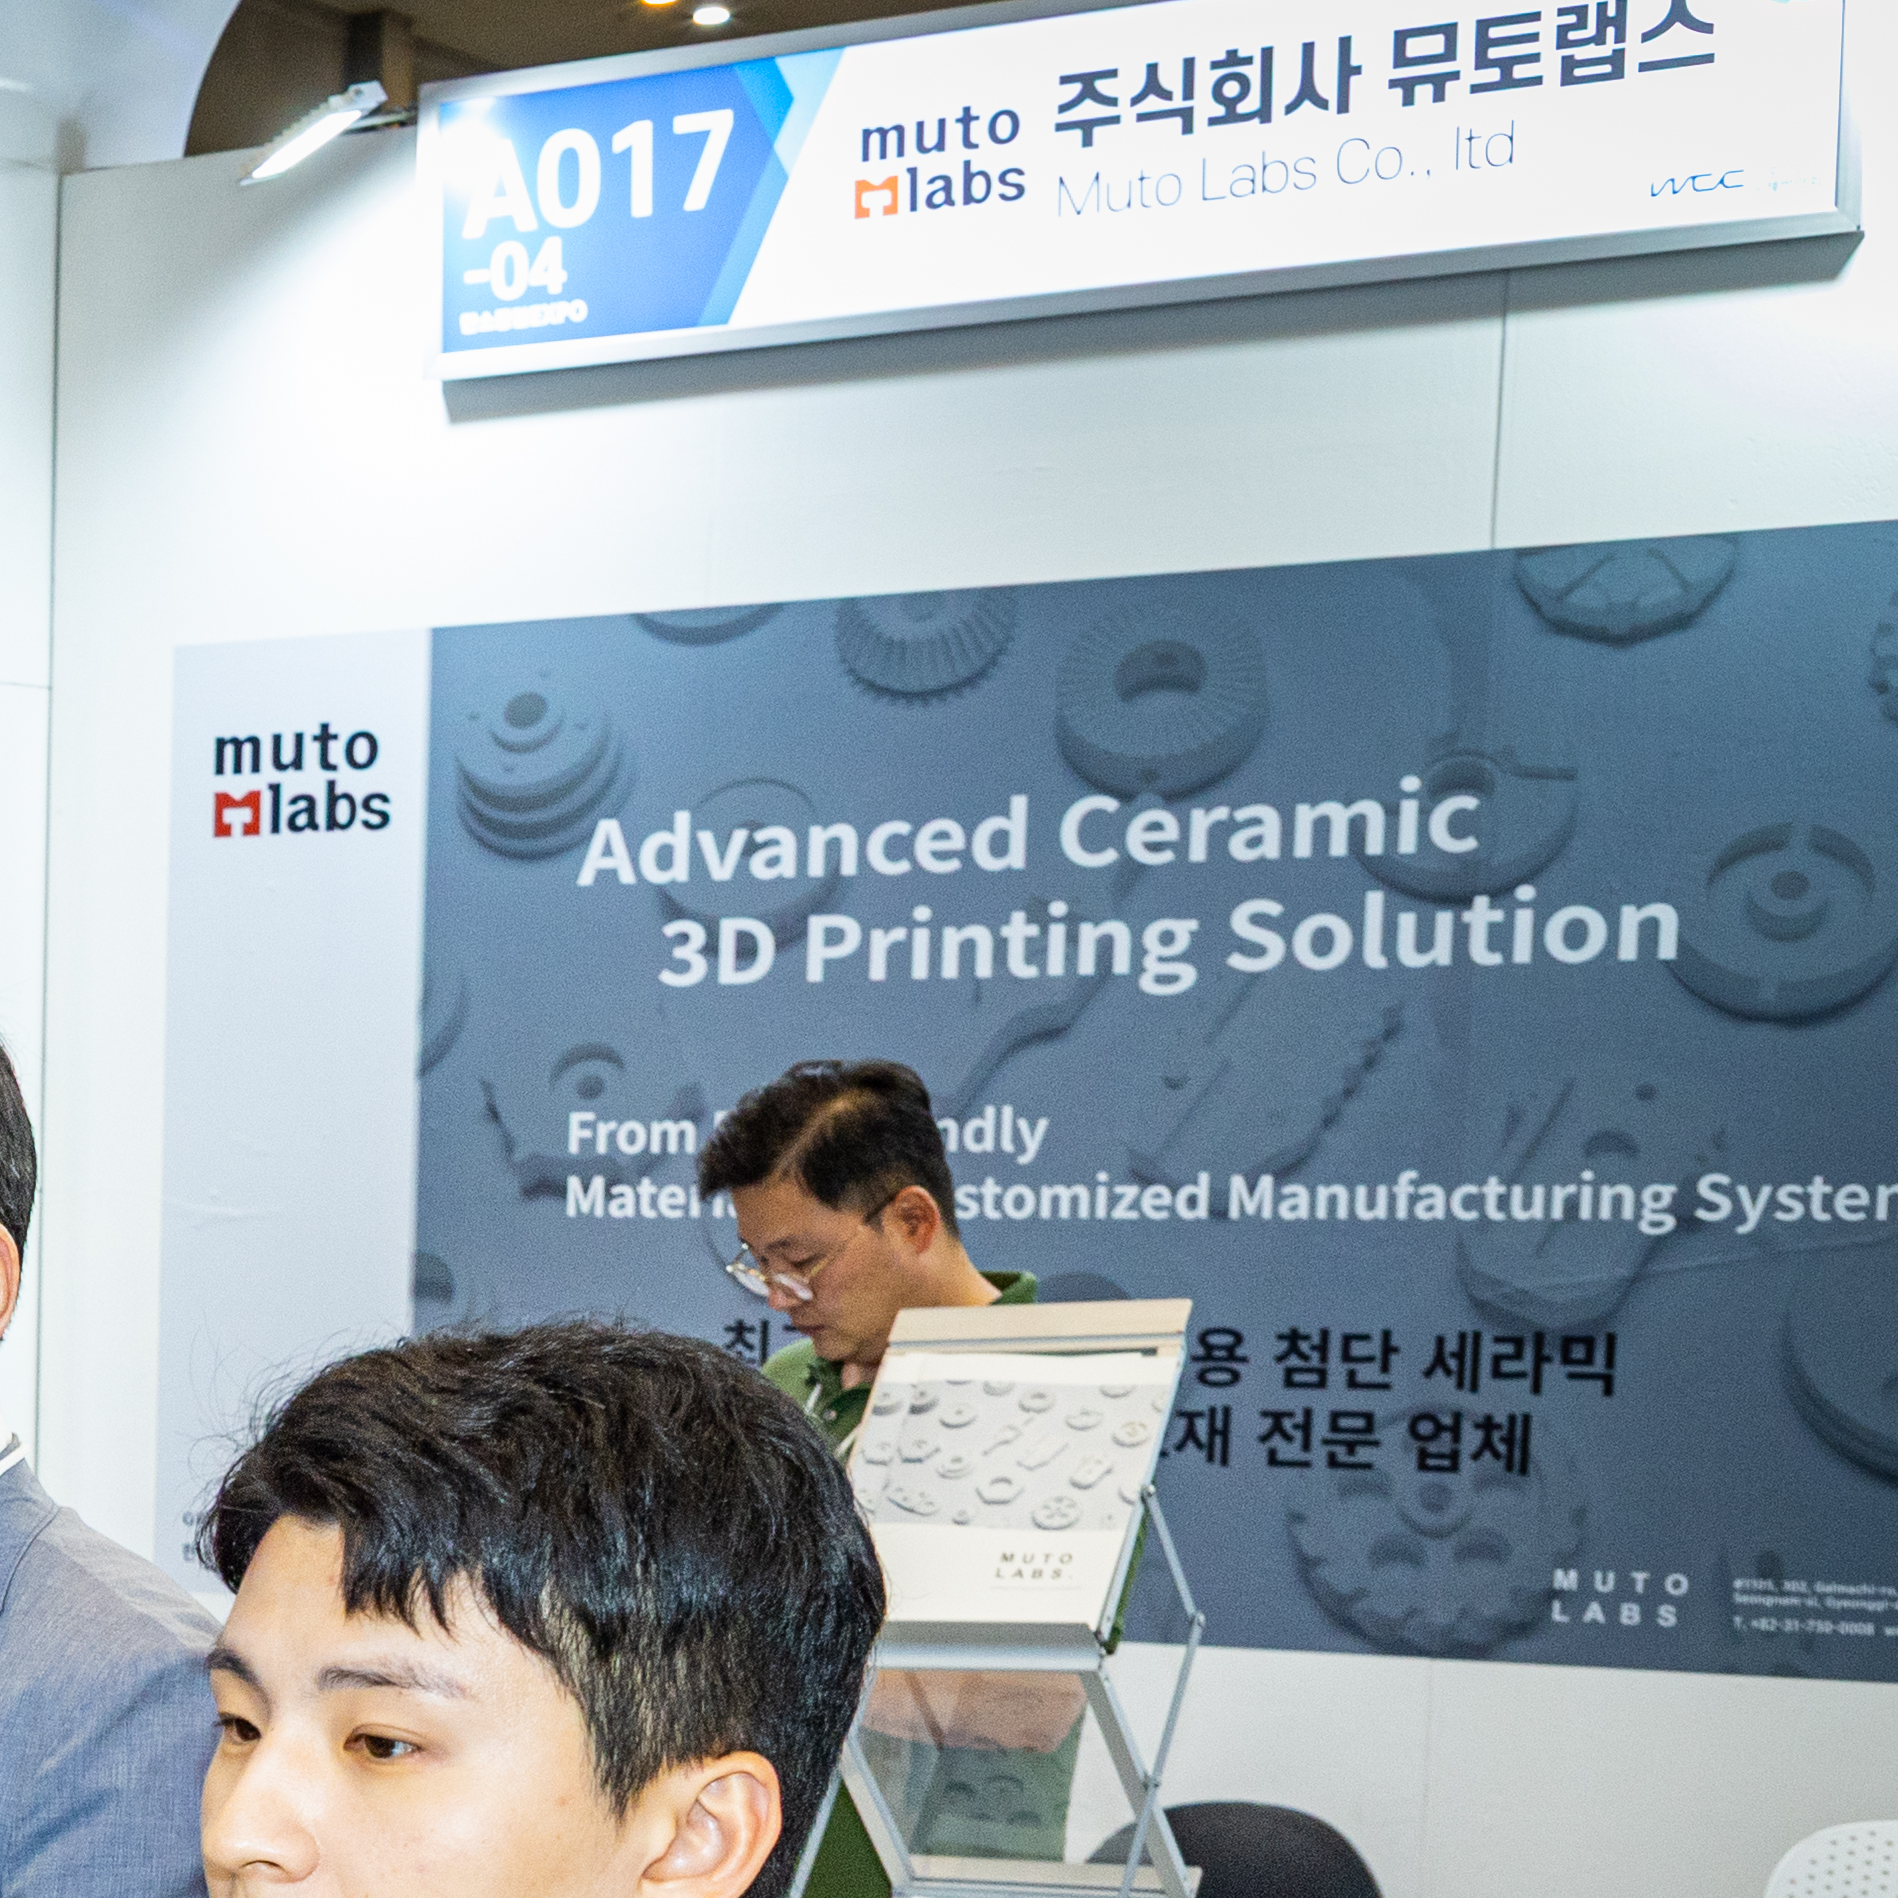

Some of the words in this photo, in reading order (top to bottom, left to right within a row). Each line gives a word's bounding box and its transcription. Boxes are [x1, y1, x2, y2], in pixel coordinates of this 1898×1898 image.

[1054, 35, 1363, 149] 주식회사
[1387, 0, 1717, 108] 뮤토랩스
[860, 104, 1021, 163] muto
[462, 108, 735, 240] A017
[908, 161, 1027, 213] labs
[1057, 171, 1183, 218] Muto
[1202, 146, 1317, 203] Labs
[1336, 137, 1433, 185] Co.,
[464, 237, 568, 299] -04
[214, 722, 379, 776] muto
[269, 781, 392, 835] labs
[577, 795, 1029, 888] Advanced
[1059, 775, 1481, 868] Ceramic
[658, 915, 776, 989] 3D
[805, 900, 1199, 996] Printing
[1226, 885, 1681, 973] Solution
[567, 1111, 696, 1155] From
[938, 1106, 1049, 1165] ndly
[953, 1174, 1208, 1222] stomized
[1228, 1168, 1677, 1236] Manufacturing
[1275, 1329, 1399, 1392] 첨단
[1423, 1330, 1618, 1396] 세라믹
[1163, 1404, 1233, 1467] 재
[1258, 1409, 1381, 1470] 전문
[1408, 1410, 1533, 1475] 업체
[1000, 1552, 1073, 1565] MUTO
[1553, 1568, 1689, 1597] MUTO
[1551, 1600, 1680, 1629] LABS
